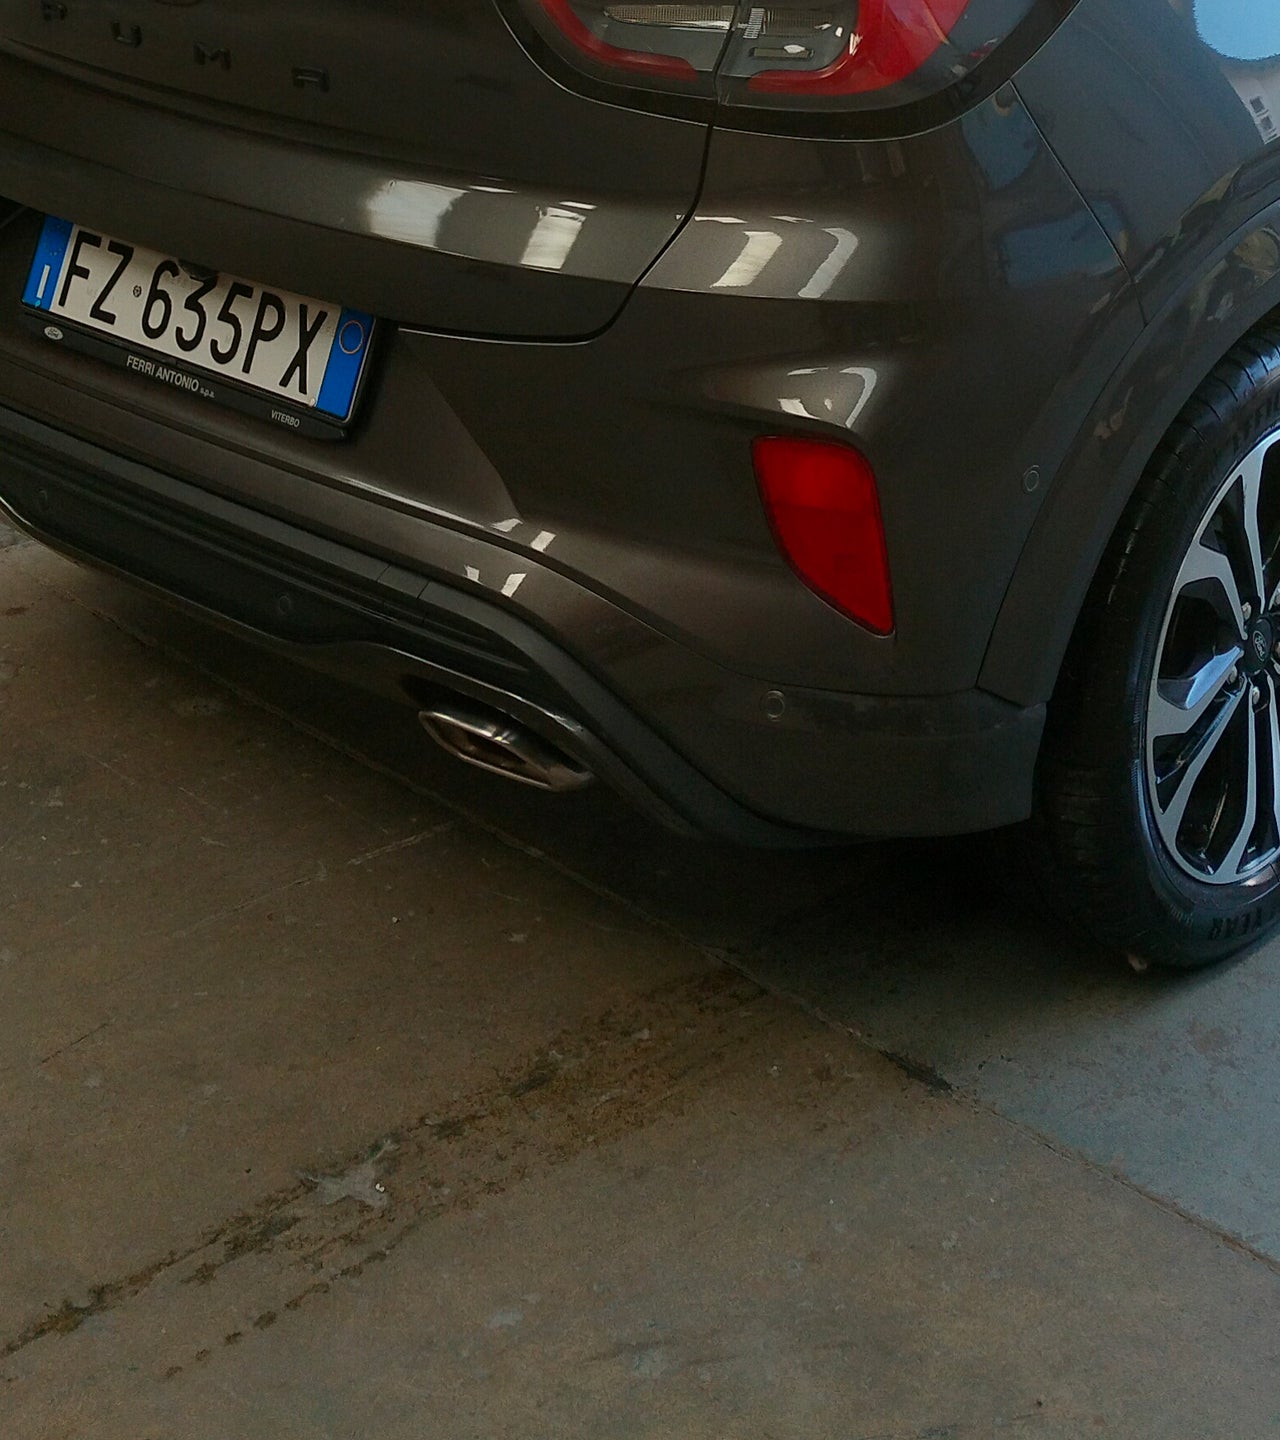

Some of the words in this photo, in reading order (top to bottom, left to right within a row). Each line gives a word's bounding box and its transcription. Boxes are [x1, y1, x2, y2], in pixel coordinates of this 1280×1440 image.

[126, 355, 155, 376] FERRI
[156, 367, 200, 392] ANTONIO
[271, 410, 301, 428] VITERBO
